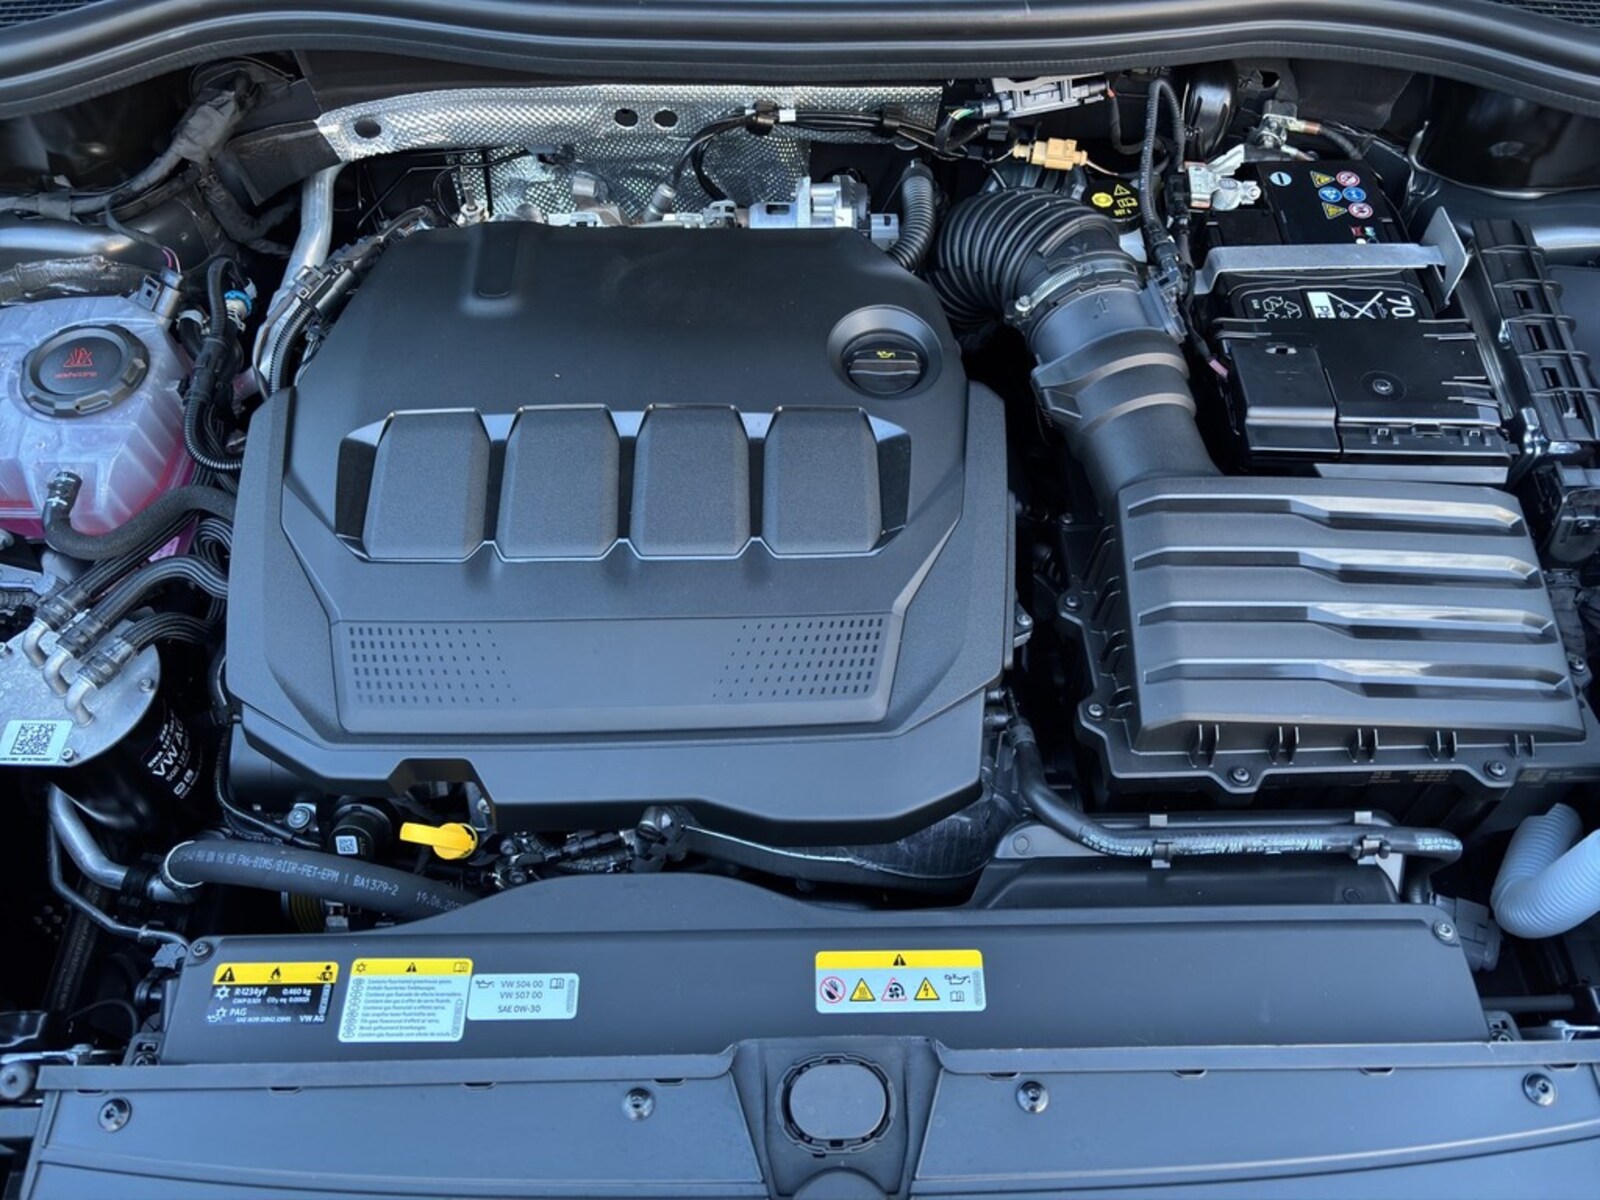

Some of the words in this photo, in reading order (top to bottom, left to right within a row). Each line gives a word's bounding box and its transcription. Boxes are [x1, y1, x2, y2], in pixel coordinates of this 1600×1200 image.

[1386, 295, 1416, 319] 70
[152, 744, 178, 776] VW
[353, 874, 400, 897] BA1379-2
[501, 980, 514, 988] VW
[515, 980, 532, 988] 504
[532, 980, 544, 988] 00
[500, 991, 514, 999] VW
[515, 991, 530, 999] 507
[531, 991, 543, 999] 00
[229, 1008, 247, 1016] PAG
[498, 1005, 512, 1013] SAE
[513, 1004, 541, 1013] 0W-30
[299, 1015, 313, 1023] VW
[313, 1015, 325, 1023] AG
